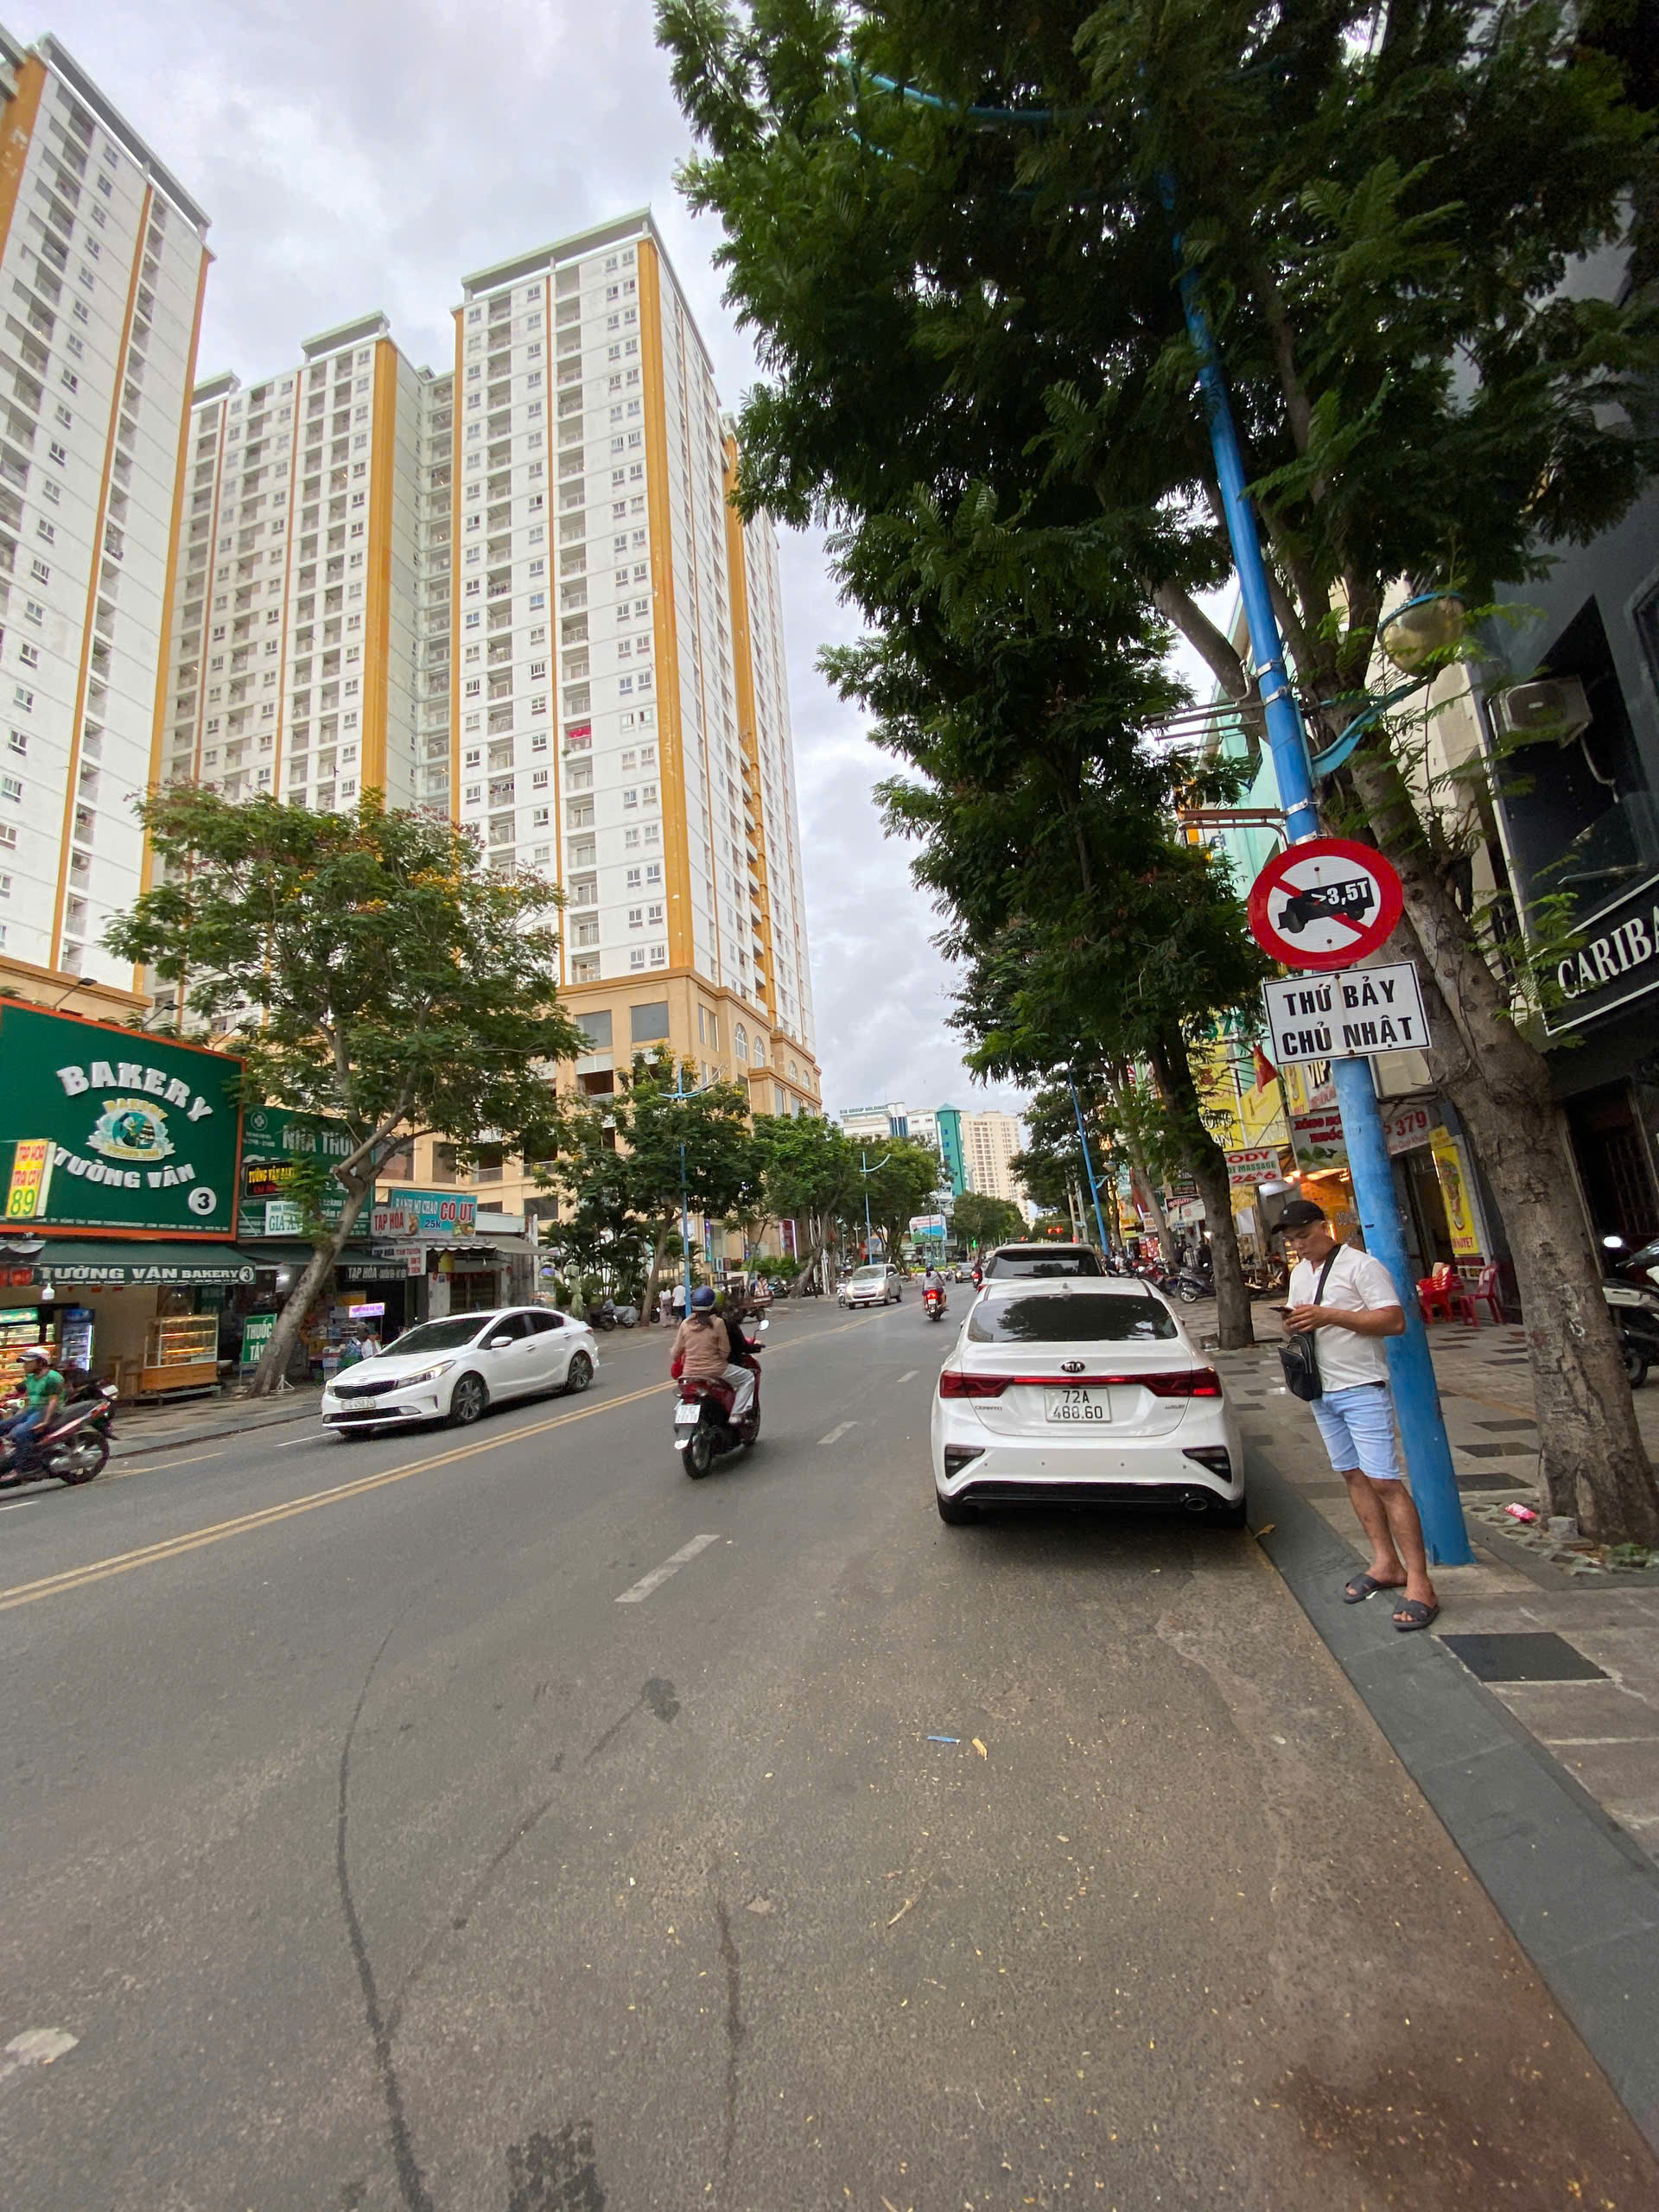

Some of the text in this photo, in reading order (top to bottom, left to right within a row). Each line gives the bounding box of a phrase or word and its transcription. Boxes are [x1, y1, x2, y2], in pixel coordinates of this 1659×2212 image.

[1283, 976, 1395, 1017] THỨ BẢY
[1282, 1014, 1413, 1056] CHỦ NHẬT
[57, 1061, 213, 1122] BAKERY
[1395, 1111, 1427, 1136] 379
[54, 1147, 196, 1188] TƯỜNG VÂN
[1228, 1151, 1270, 1164] ODY
[1237, 1160, 1276, 1173] MASSAGE
[10, 1189, 35, 1215] 89
[197, 1192, 210, 1210] 3
[440, 1198, 474, 1222] CÔ ÚT
[374, 1214, 387, 1234] TẠP
[389, 1211, 404, 1230] HÓA
[41, 1265, 251, 1280] TƯỜNG VÂN BAKERY 3
[362, 1265, 378, 1279] HÓA
[1064, 1363, 1082, 1371] KIA
[1062, 1389, 1090, 1404] 72A
[1053, 1406, 1103, 1419] 488.60
